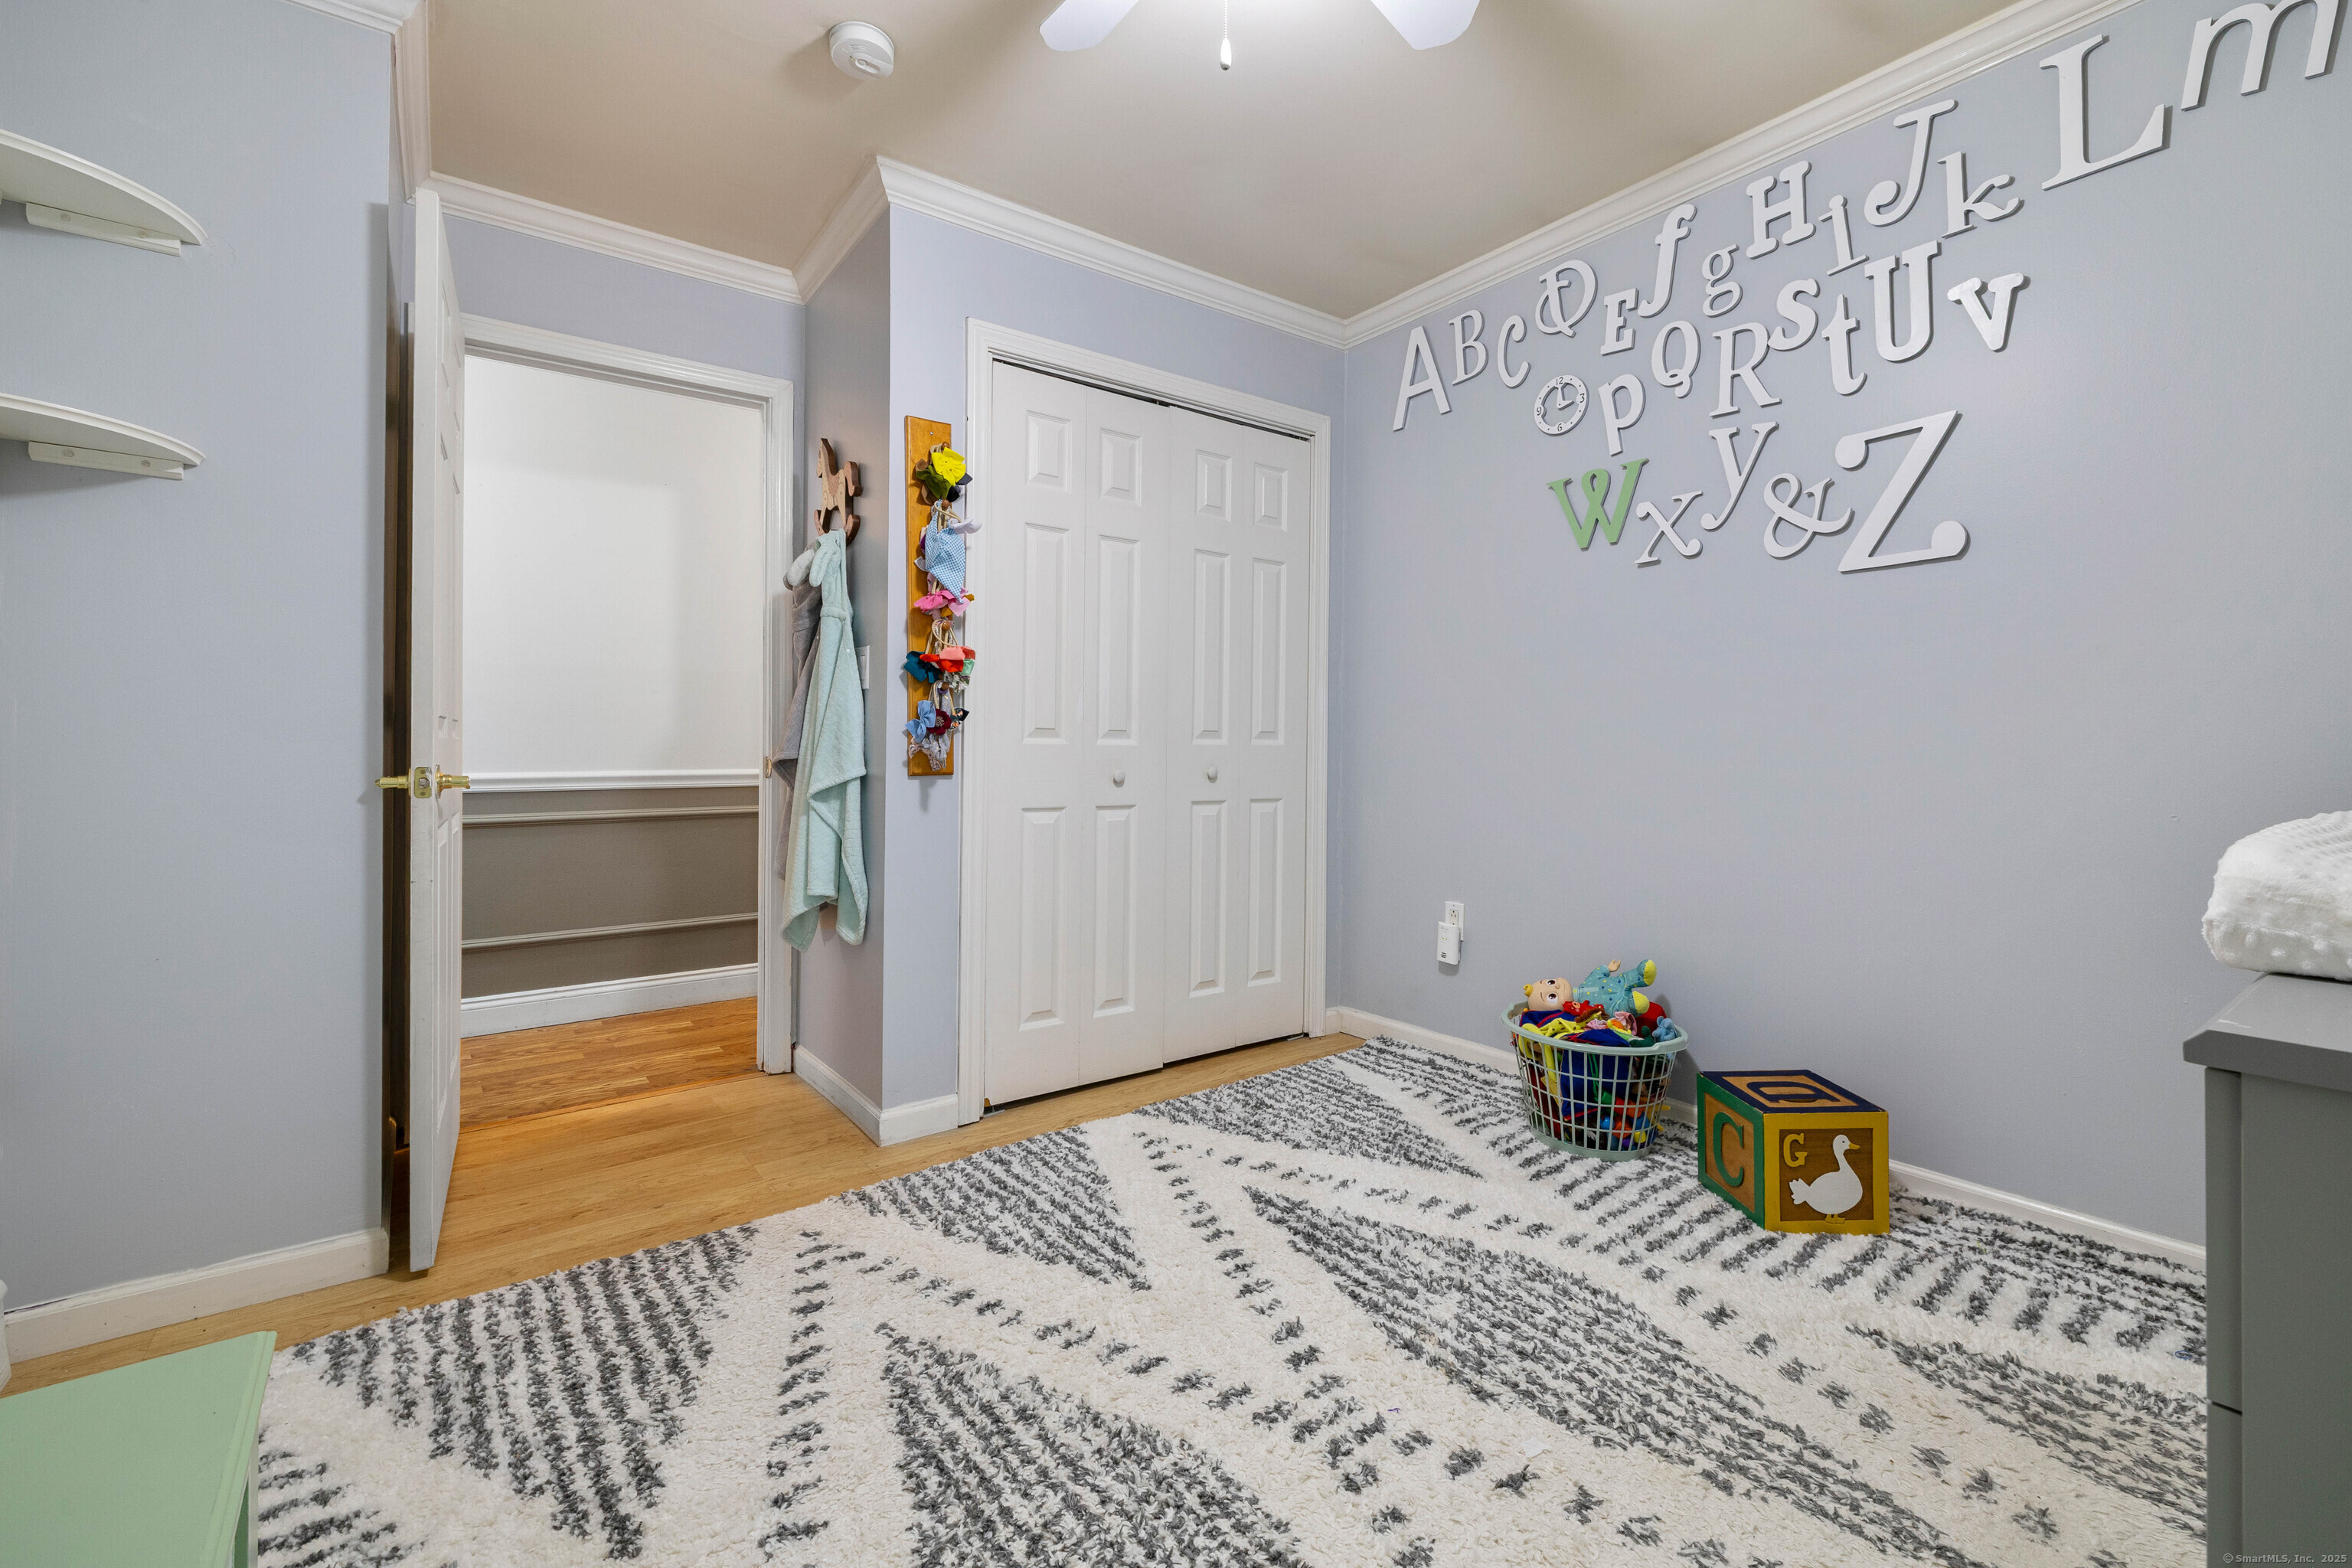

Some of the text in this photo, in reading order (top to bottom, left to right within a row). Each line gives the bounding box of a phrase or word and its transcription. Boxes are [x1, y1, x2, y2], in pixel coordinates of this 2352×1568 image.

[1393, 325, 1452, 432] A
[1449, 310, 1488, 385] B
[1600, 288, 1639, 354] E
[1638, 204, 1697, 316] f
[1702, 244, 1743, 317] g
[1746, 161, 1816, 260] H
[1864, 100, 1958, 226] J
[2040, 34, 2168, 190] L
[1651, 320, 1700, 398] Q
[1710, 322, 1782, 417] R
[1822, 294, 1867, 396] t
[1864, 240, 1942, 362] U
[1556, 377, 1563, 386] 12
[1579, 393, 1585, 403] 3
[1763, 473, 1854, 559] &
[1713, 1112, 1744, 1187] C
[1783, 1133, 1808, 1168] G
